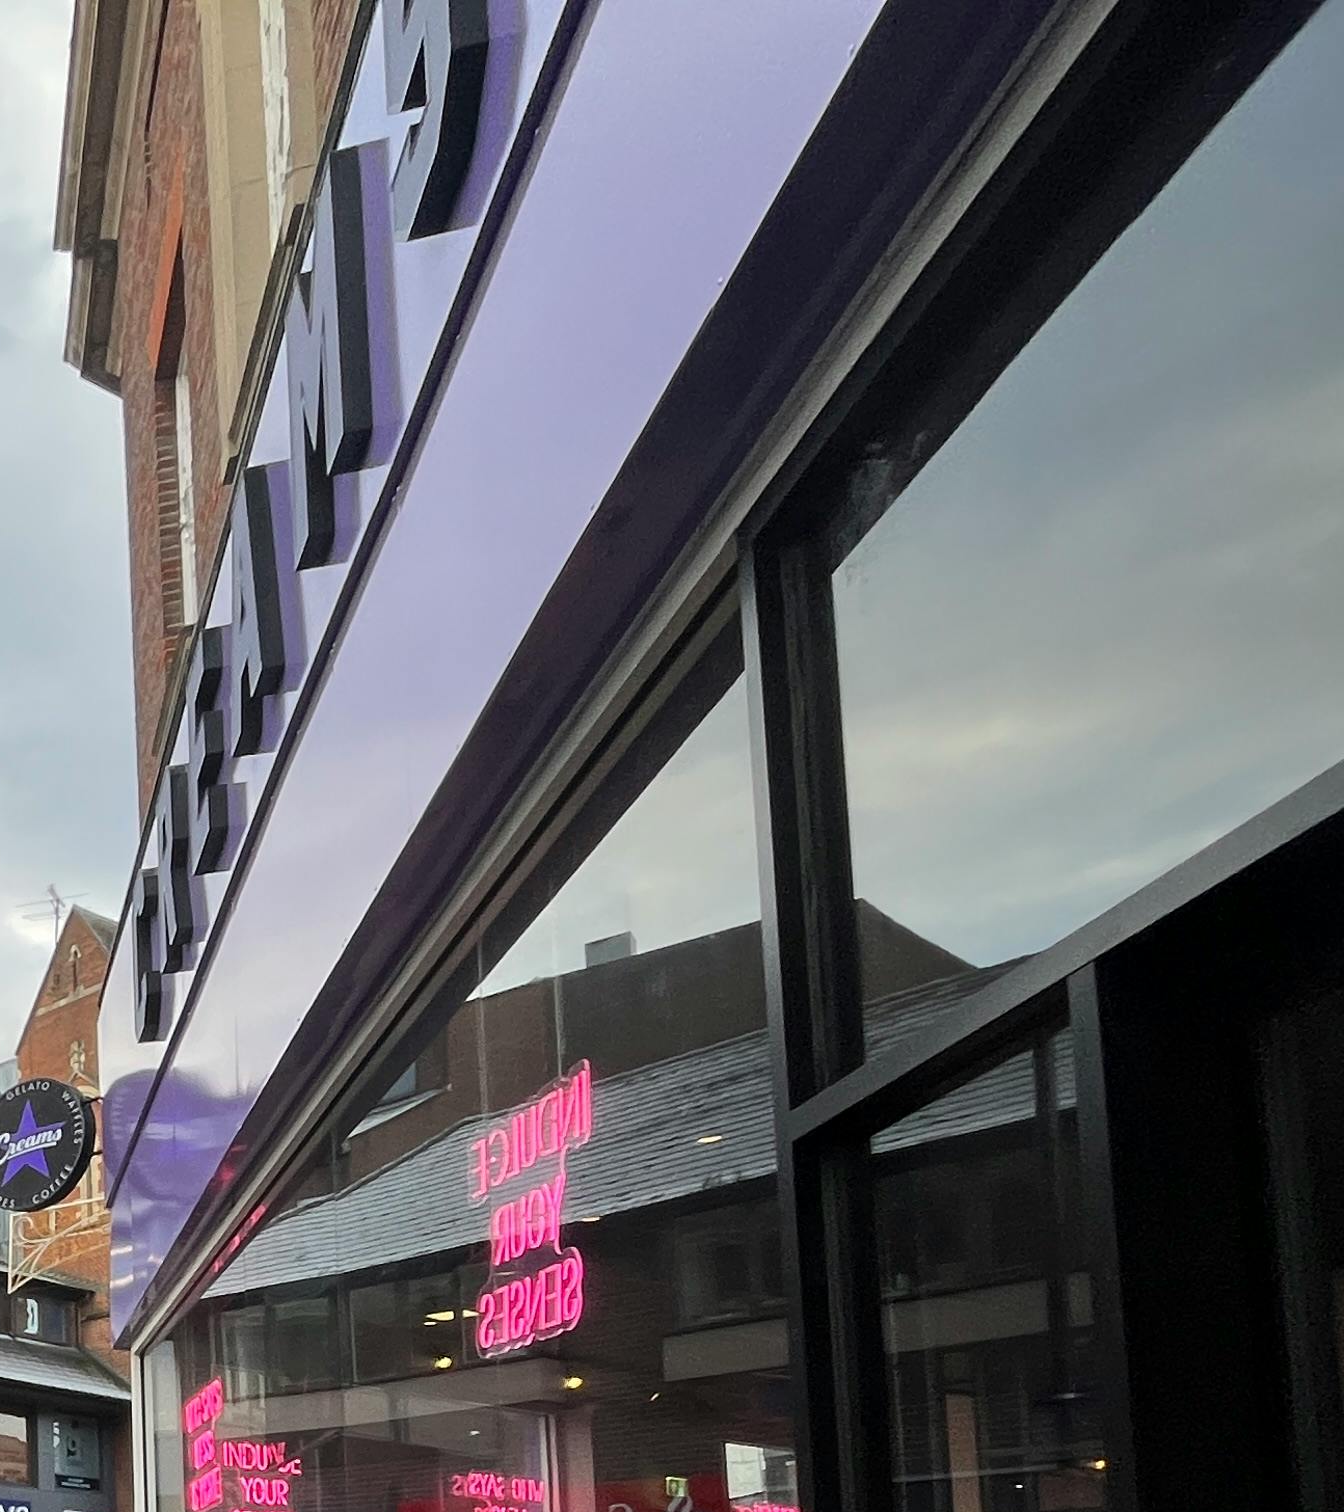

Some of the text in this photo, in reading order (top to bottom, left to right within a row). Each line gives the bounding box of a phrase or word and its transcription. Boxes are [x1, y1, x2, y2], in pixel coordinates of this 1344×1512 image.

[6, 1081, 50, 1101] GELATO
[61, 1090, 84, 1144] WAFFLES
[32, 1164, 74, 1204] COFFEE
[240, 1476, 289, 1506] YOUR
